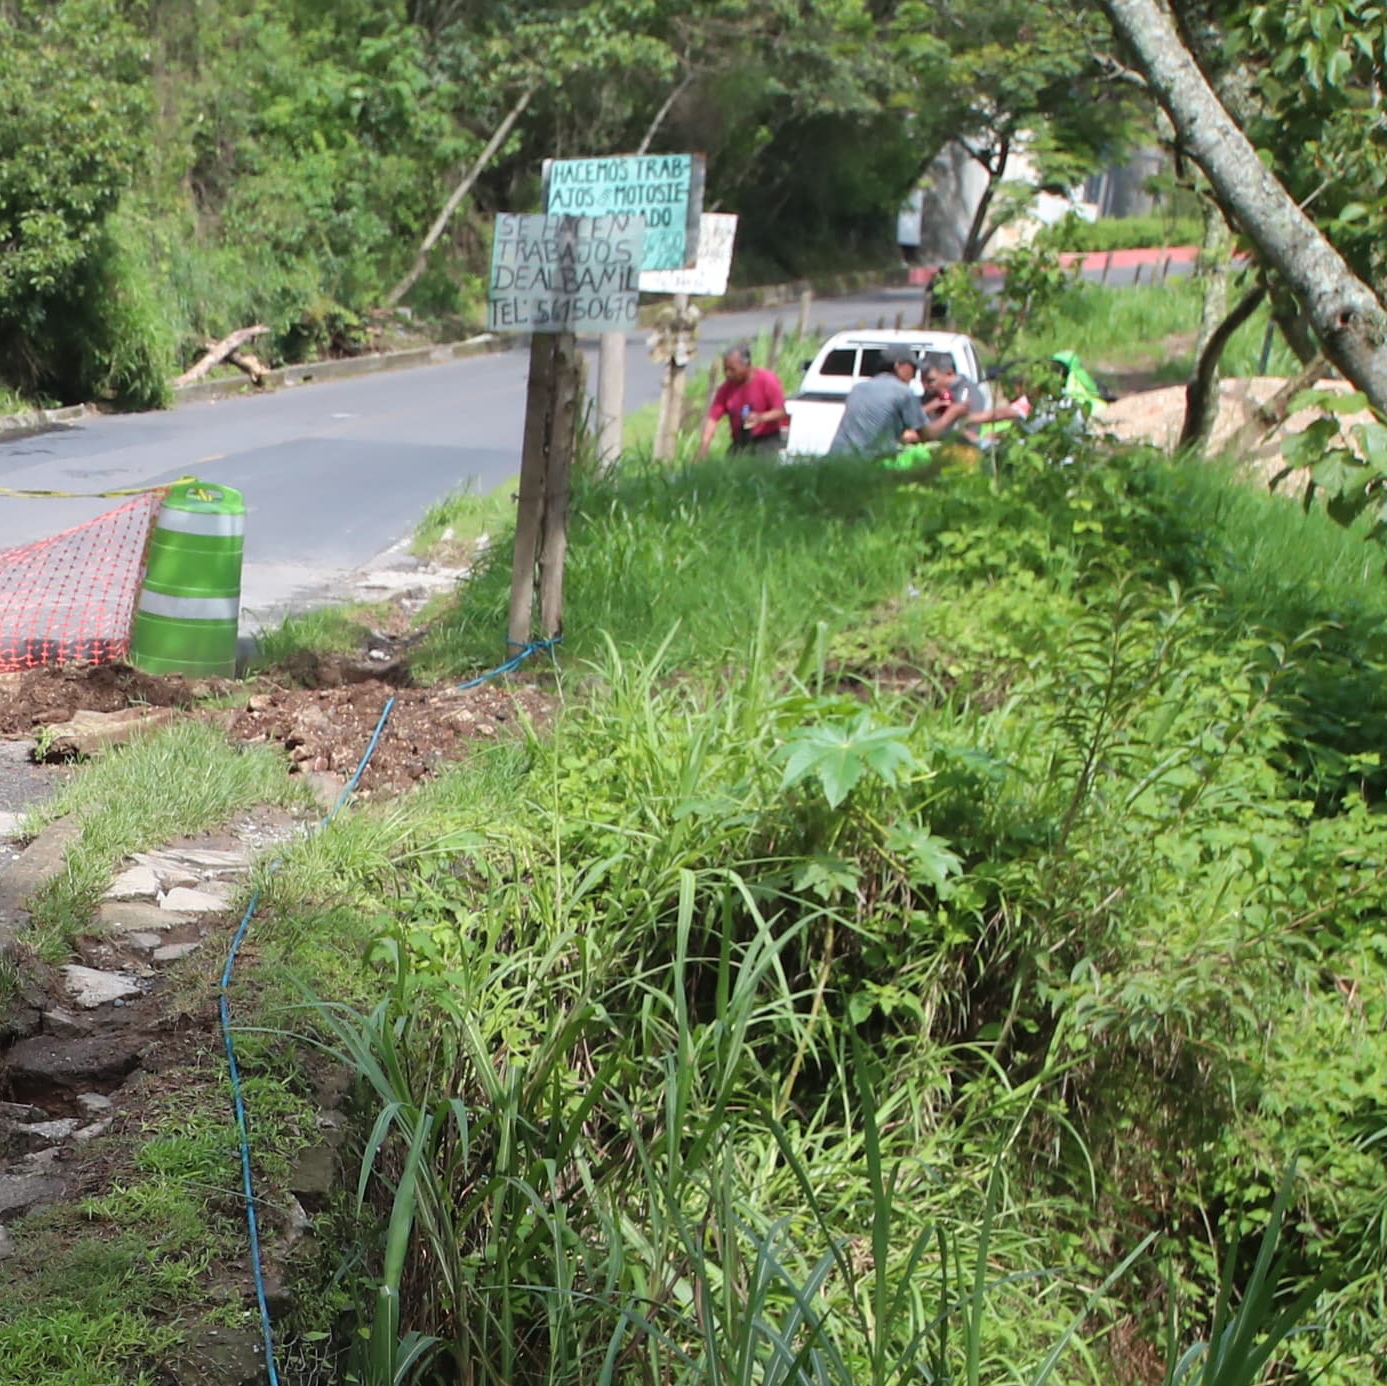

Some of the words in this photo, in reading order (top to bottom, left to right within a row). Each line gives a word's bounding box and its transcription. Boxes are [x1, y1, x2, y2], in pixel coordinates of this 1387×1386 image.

[553, 159, 628, 184] HACEMOS
[549, 187, 594, 208] AJOS
[502, 215, 531, 237] SE
[542, 213, 630, 240] HACEN
[496, 239, 632, 264] TRABAJOS
